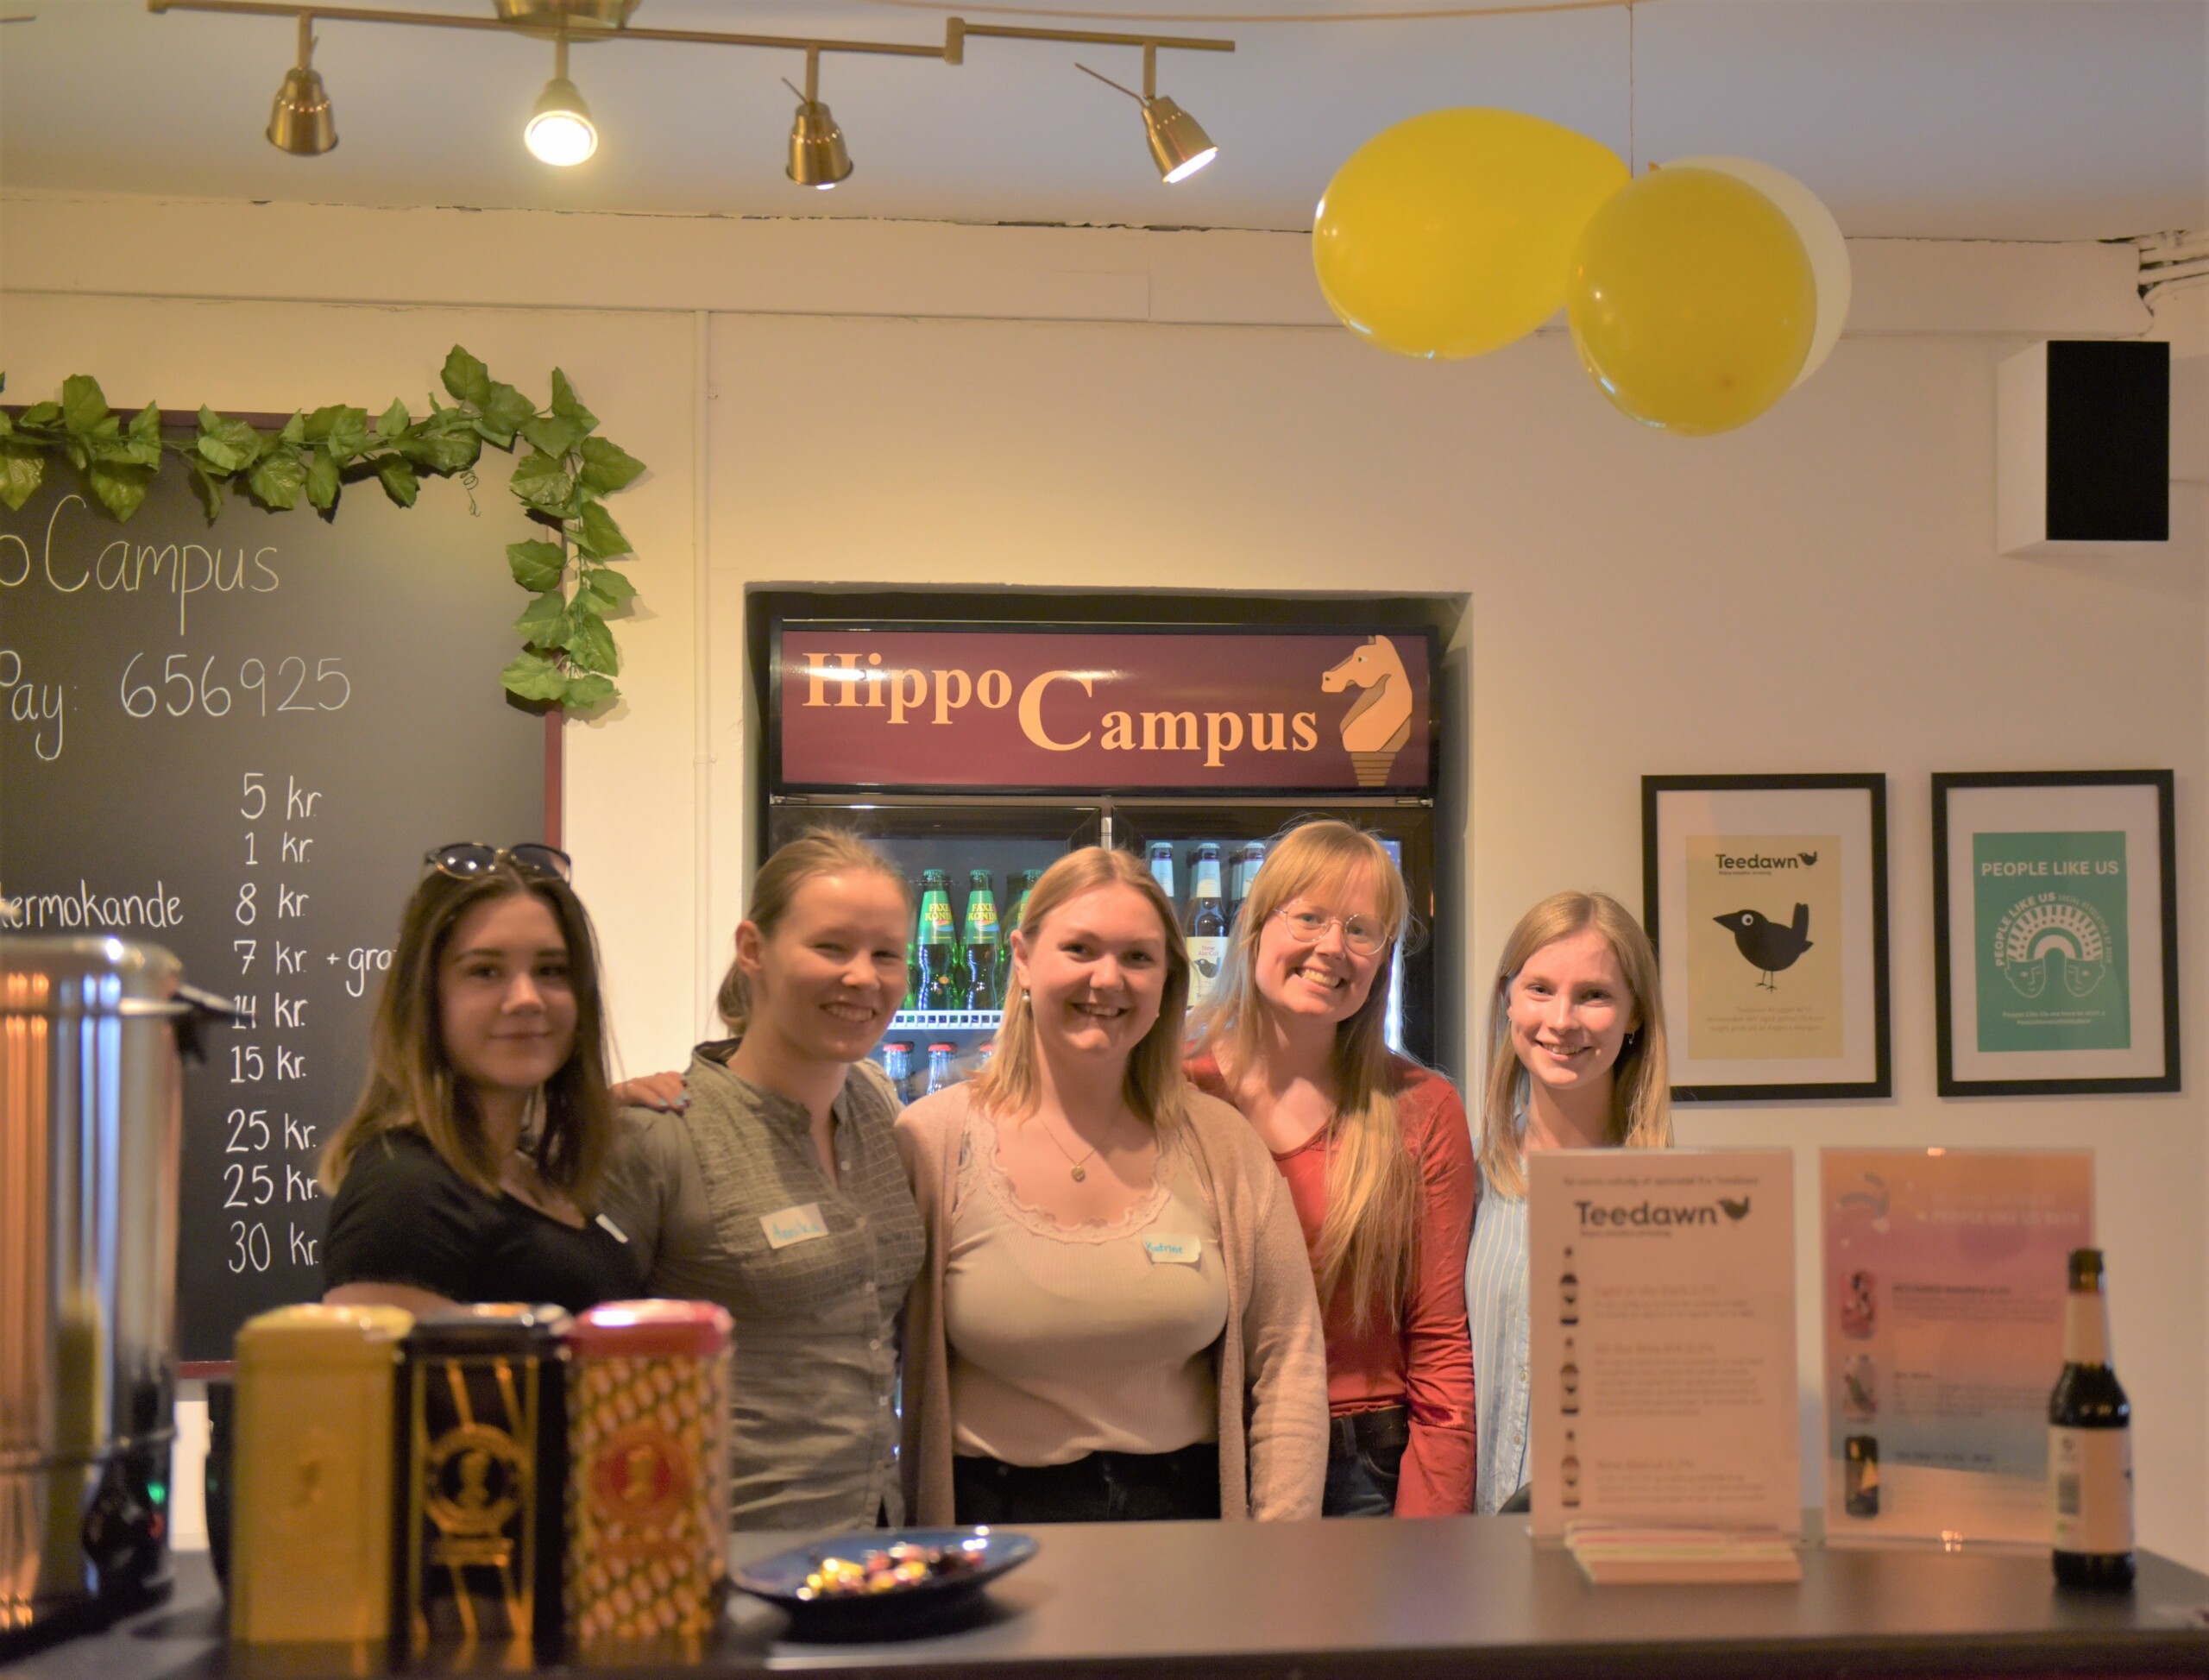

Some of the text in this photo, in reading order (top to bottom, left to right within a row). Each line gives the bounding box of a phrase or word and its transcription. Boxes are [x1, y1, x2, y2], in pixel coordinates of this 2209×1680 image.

[121, 652, 351, 718] 656925
[240, 772, 267, 820] 5
[244, 832, 260, 865] 1
[1715, 853, 1799, 869] Teedawn
[1981, 860, 2120, 877] PEOPLE LIKE US
[235, 882, 258, 926] 8
[972, 903, 995, 912] FAXE
[1993, 916, 2012, 967] PEOPLE
[2008, 896, 2037, 918] LIKE
[2037, 891, 2056, 903] US
[233, 940, 258, 976] 7
[345, 947, 398, 997] gro
[229, 1045, 264, 1084] 15
[224, 1108, 270, 1154] 25
[223, 1163, 274, 1209] 25
[1573, 1199, 1718, 1226] Teedawn
[228, 1220, 271, 1274] 30
